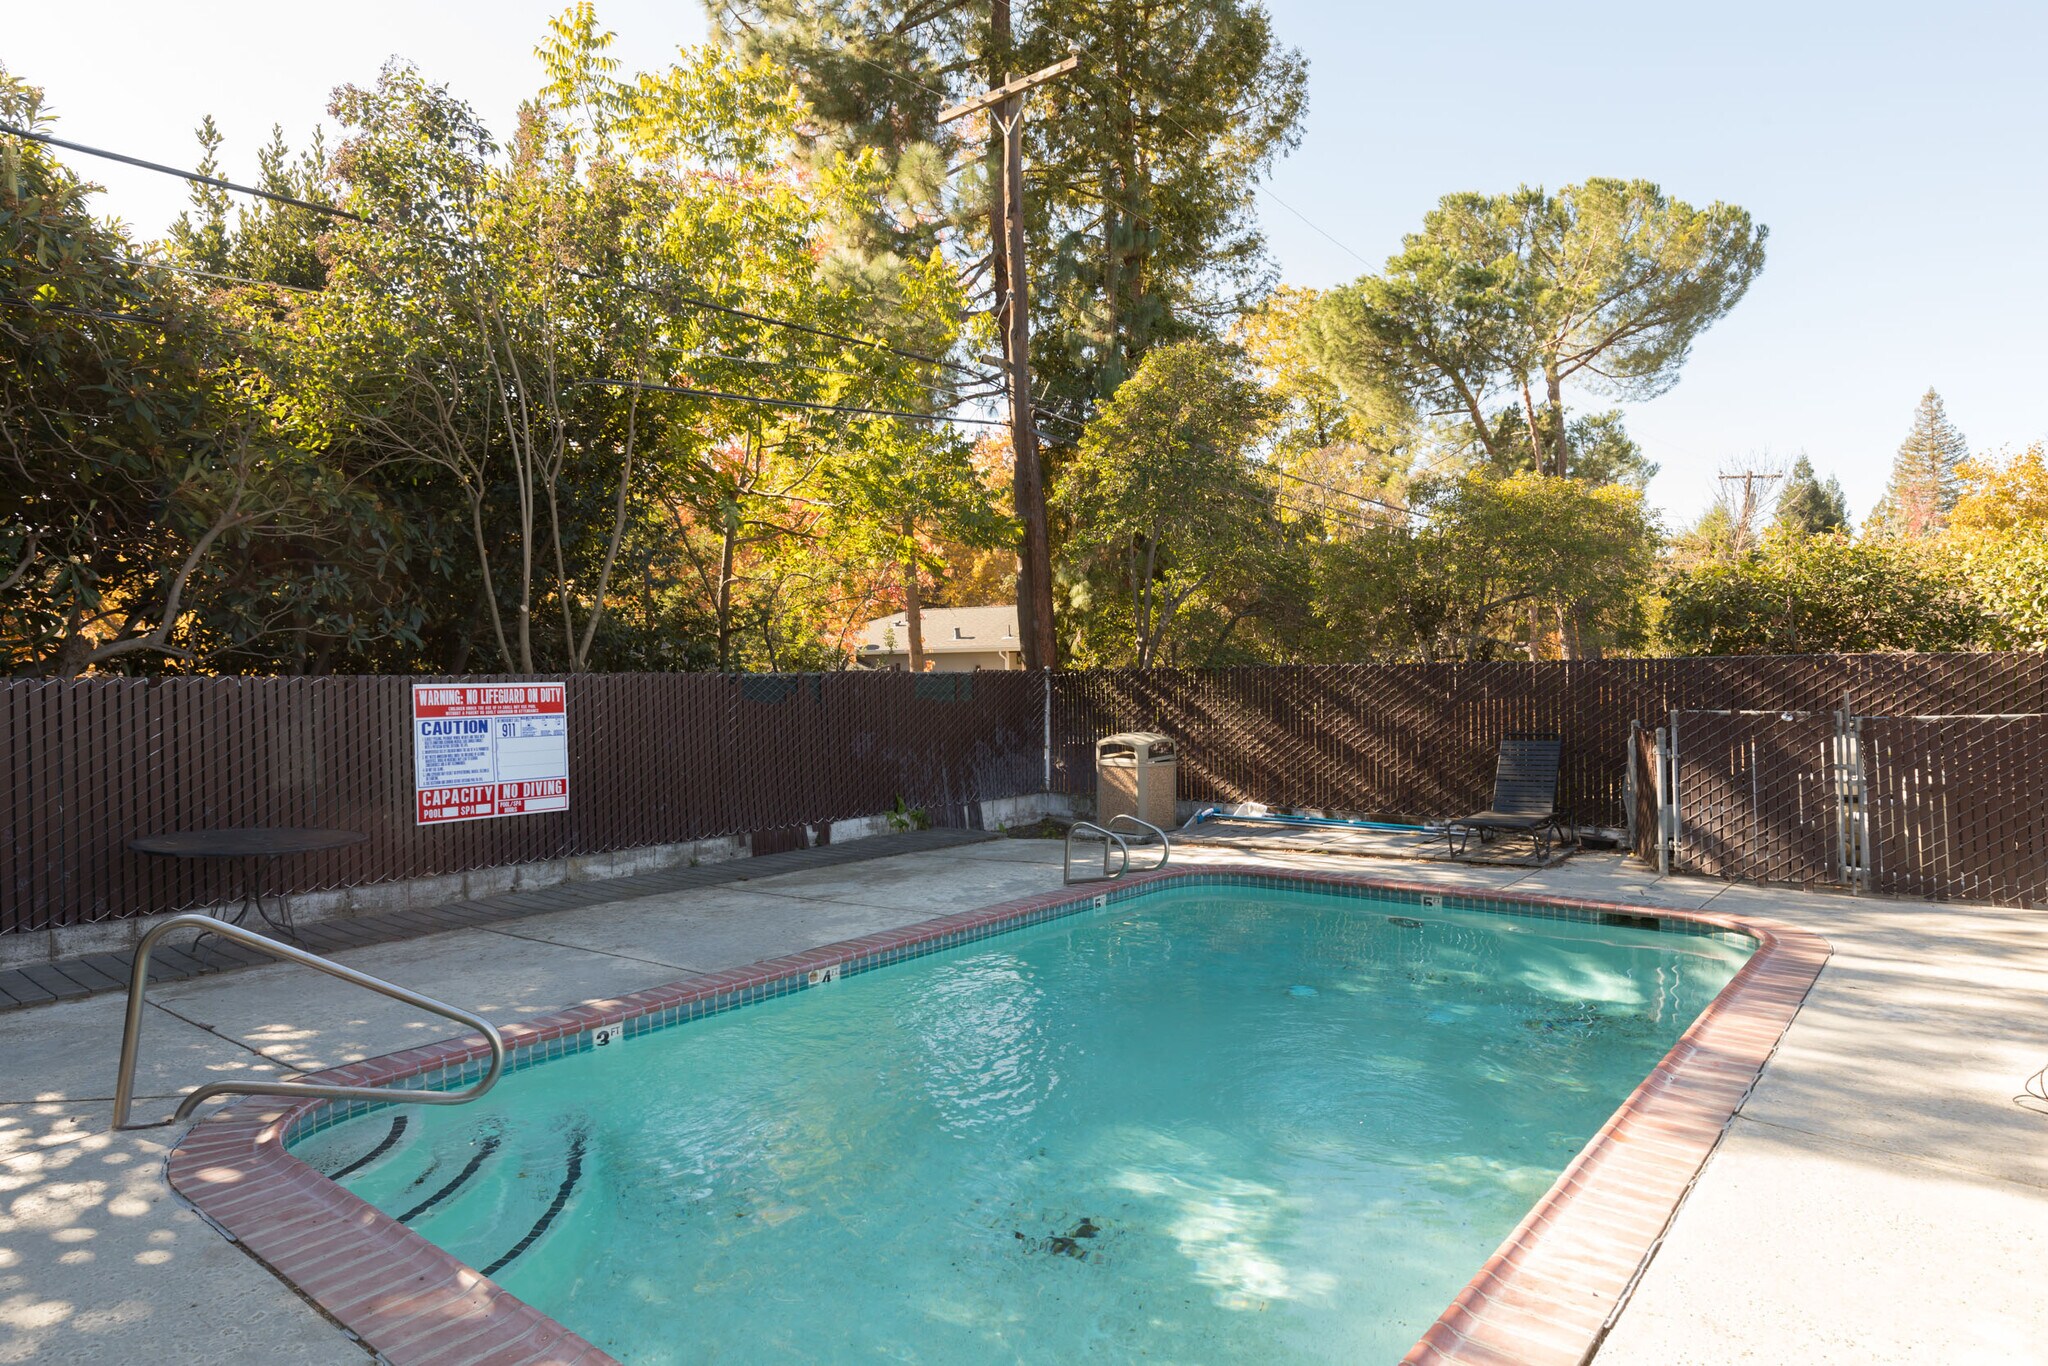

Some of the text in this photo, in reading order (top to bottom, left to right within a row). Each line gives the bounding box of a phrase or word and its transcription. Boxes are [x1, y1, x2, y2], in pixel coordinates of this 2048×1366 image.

[419, 688, 561, 706] WARNING: NO LIFEGUARD ON DUTY
[421, 720, 488, 735] CAUTION
[502, 723, 516, 737] 911
[422, 787, 493, 806] CAPACITY
[503, 780, 562, 799] NO DIVING
[424, 804, 475, 820] POOL SPA
[1423, 896, 1433, 906] 5
[822, 969, 831, 983] 4
[596, 1026, 620, 1046] 3 FT
